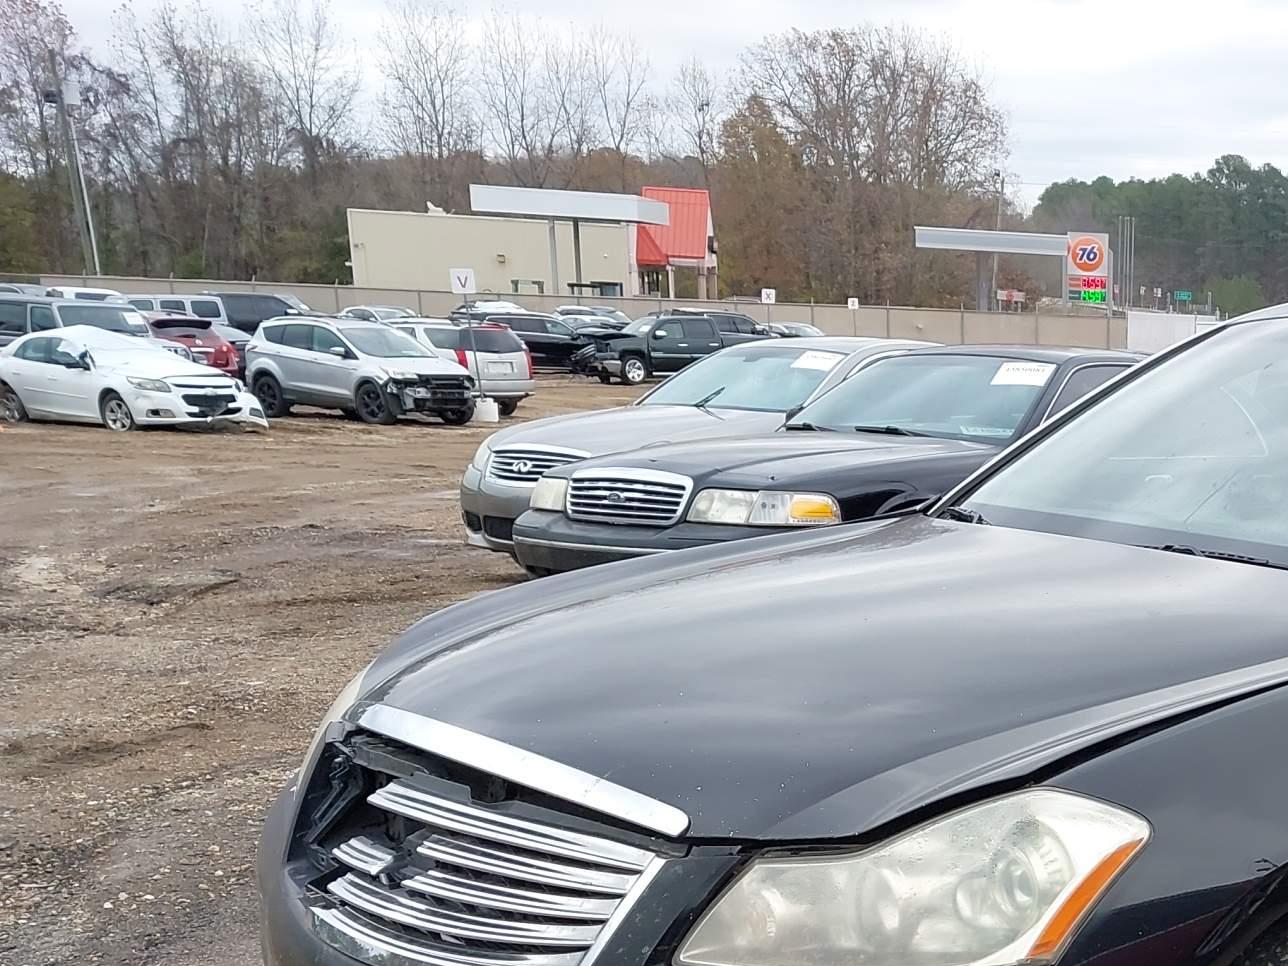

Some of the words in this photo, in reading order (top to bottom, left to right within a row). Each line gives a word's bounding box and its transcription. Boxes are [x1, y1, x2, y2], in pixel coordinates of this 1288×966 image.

[1077, 245, 1098, 262] 76
[456, 275, 468, 289] V
[764, 291, 773, 302] X
